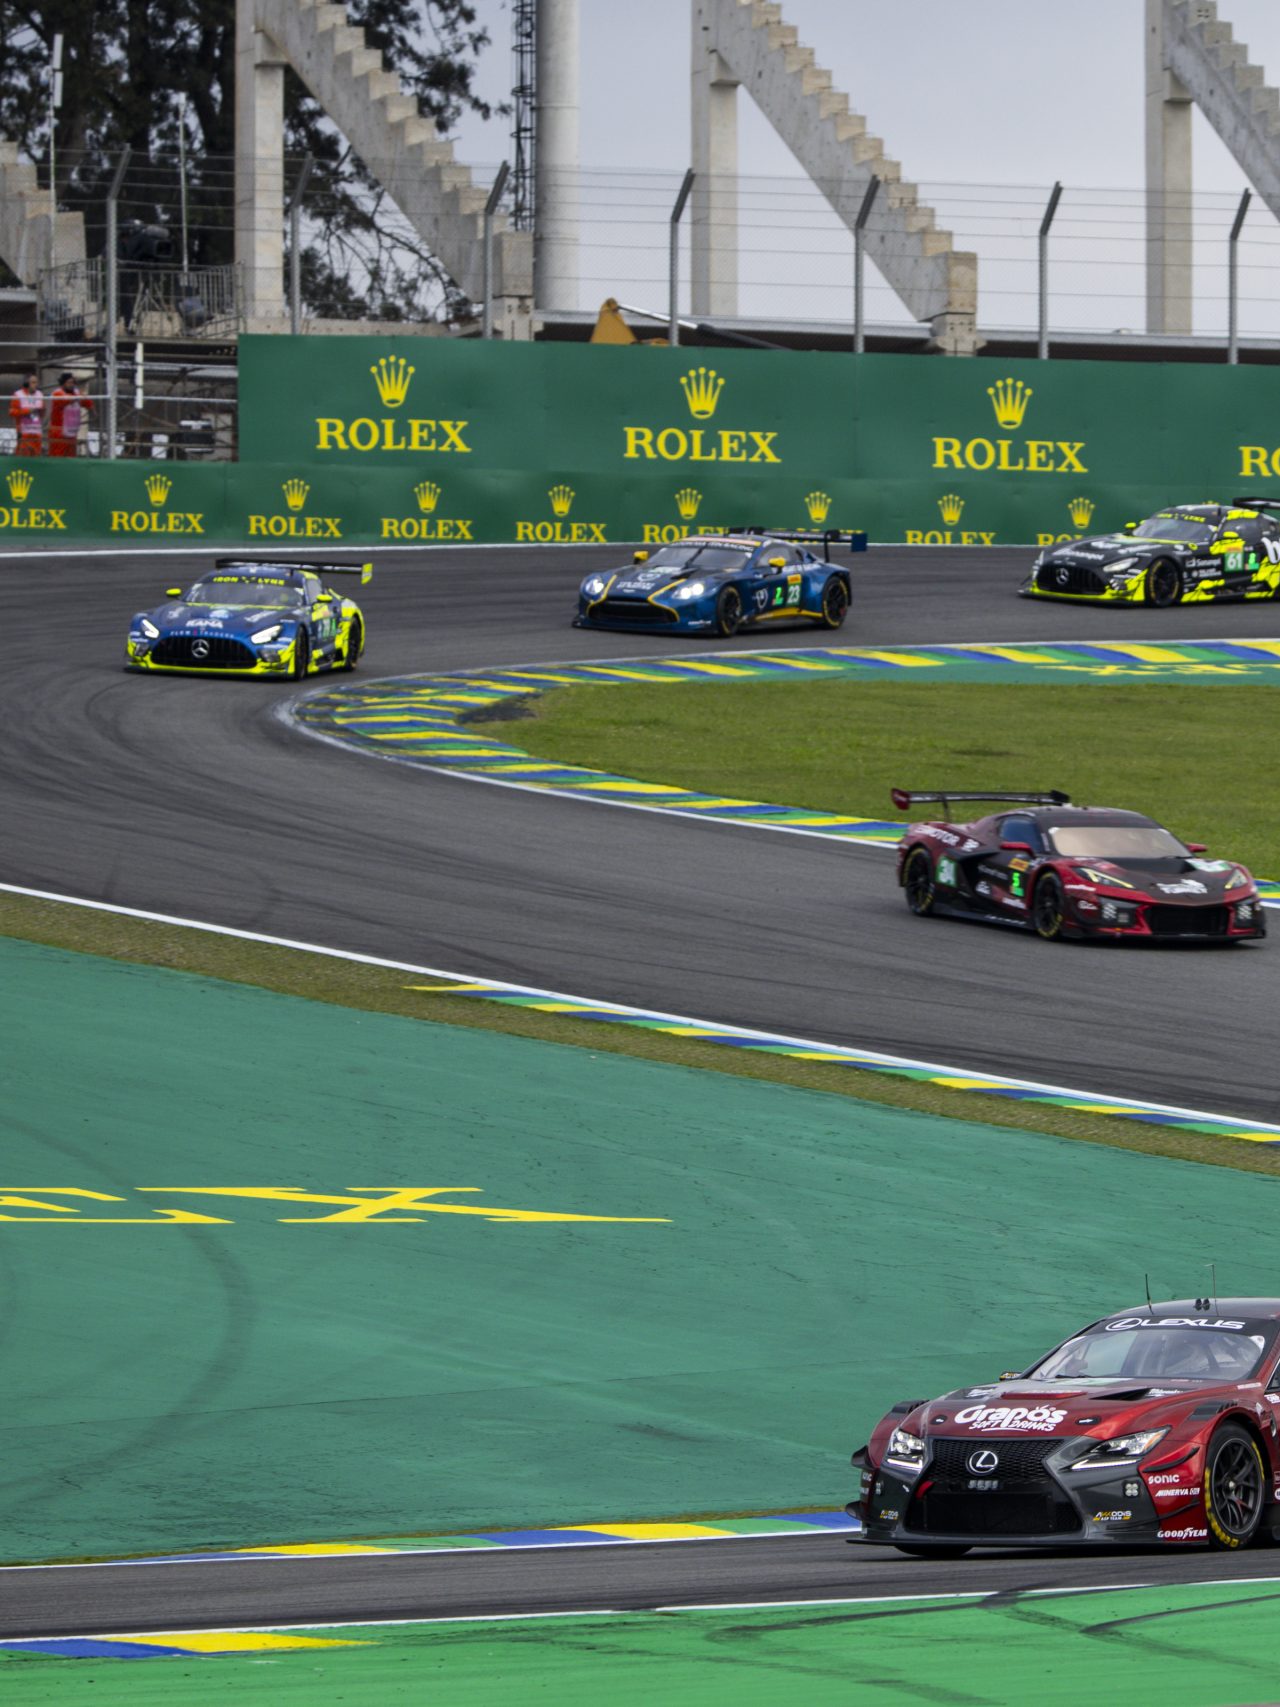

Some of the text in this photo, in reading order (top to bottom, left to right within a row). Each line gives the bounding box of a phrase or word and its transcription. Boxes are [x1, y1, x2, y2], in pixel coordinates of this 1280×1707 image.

[316, 418, 472, 453] ROLEX
[624, 427, 782, 463] ROLEX
[932, 437, 1089, 473] ROLEX
[111, 511, 204, 533] ROLEX
[248, 515, 342, 538] ROLEX
[381, 518, 473, 540] ROLEX
[516, 522, 607, 543] ROLEX
[1226, 555, 1242, 569] 61
[787, 586, 800, 603] 23
[1140, 1317, 1247, 1330] LEXUS
[968, 1420, 1057, 1432] SOFT DRINKS
[1155, 1488, 1189, 1497] MINERVA
[1156, 1527, 1208, 1540] GOODYEAR
